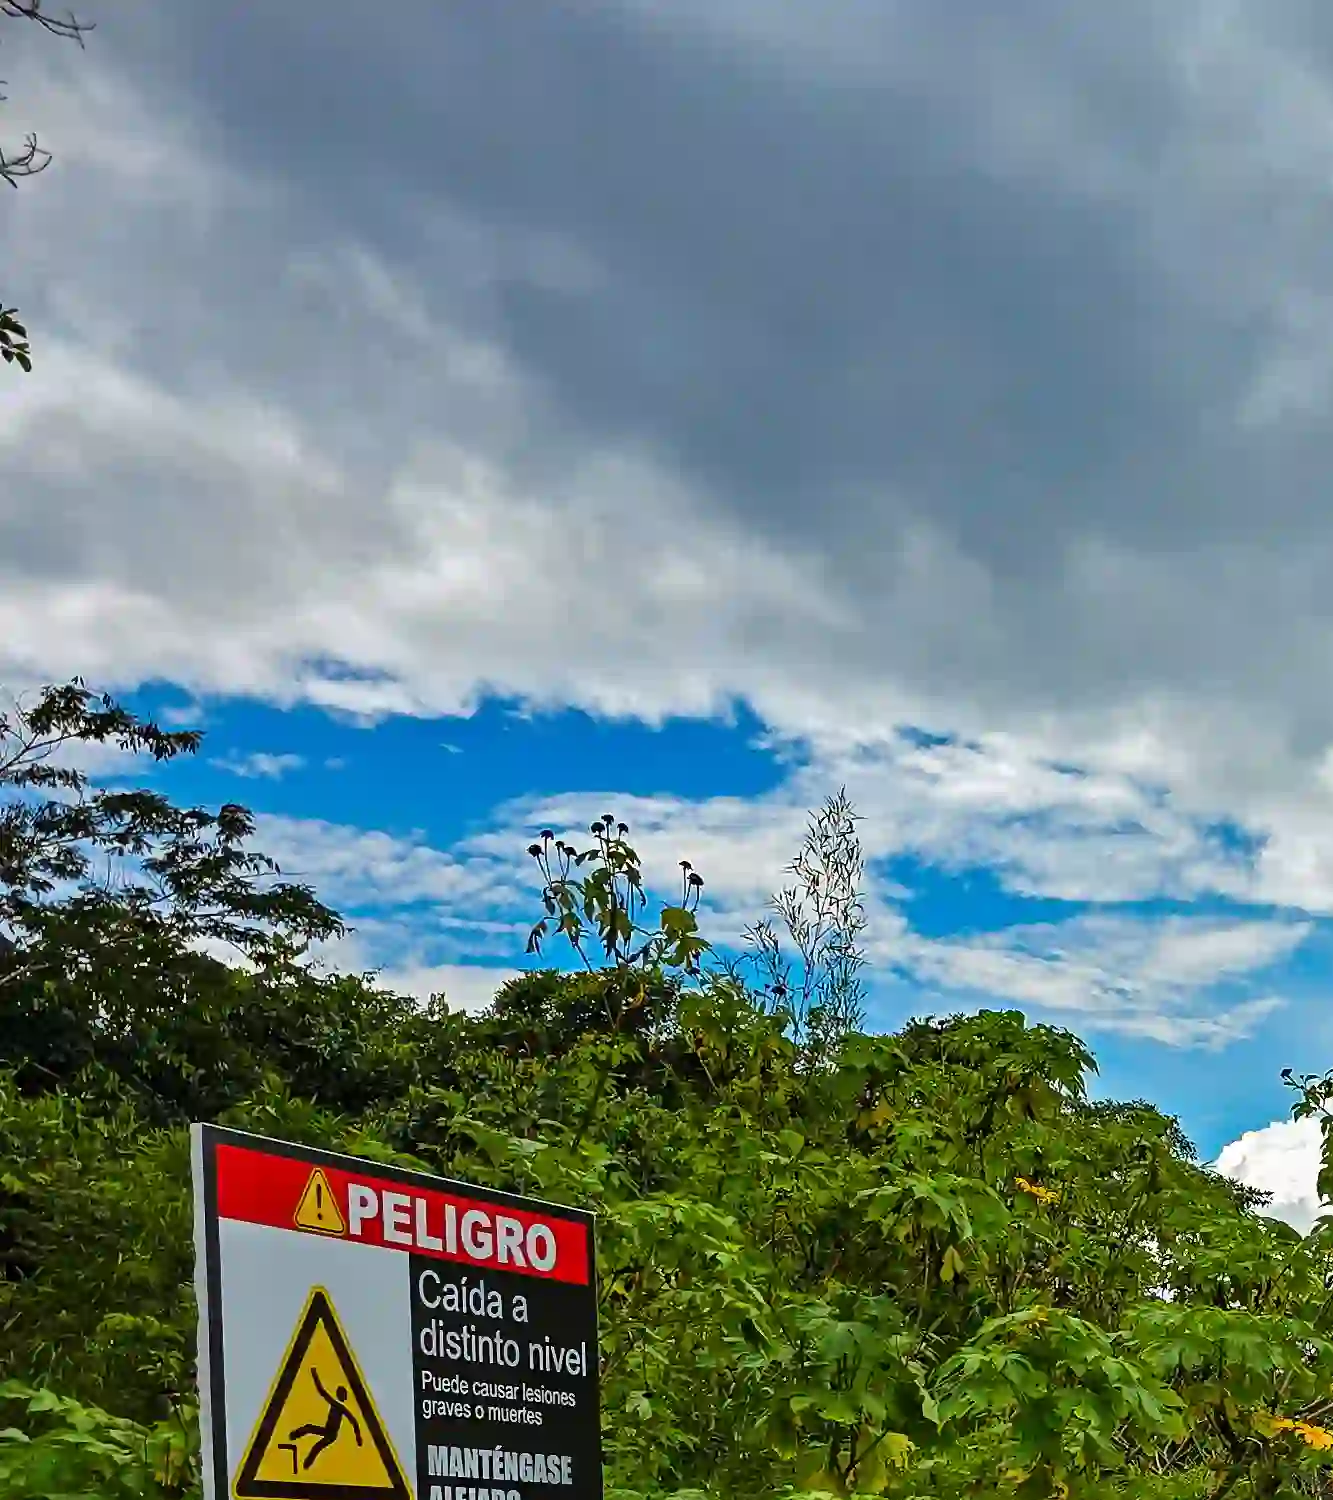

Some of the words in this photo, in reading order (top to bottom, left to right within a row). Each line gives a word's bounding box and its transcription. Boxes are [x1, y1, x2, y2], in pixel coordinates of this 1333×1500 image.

[347, 1182, 557, 1272] PELIGRO
[418, 1269, 503, 1319] Caída
[512, 1295, 528, 1323] a
[420, 1319, 520, 1367] distinto
[529, 1336, 587, 1377] nivel
[421, 1370, 469, 1395] Puede
[472, 1381, 519, 1400] causar
[522, 1382, 576, 1407] lesiones
[422, 1399, 471, 1419] graves
[474, 1405, 484, 1419] o
[488, 1405, 542, 1425] muertes
[427, 1444, 573, 1485] MANTÉNGASE
